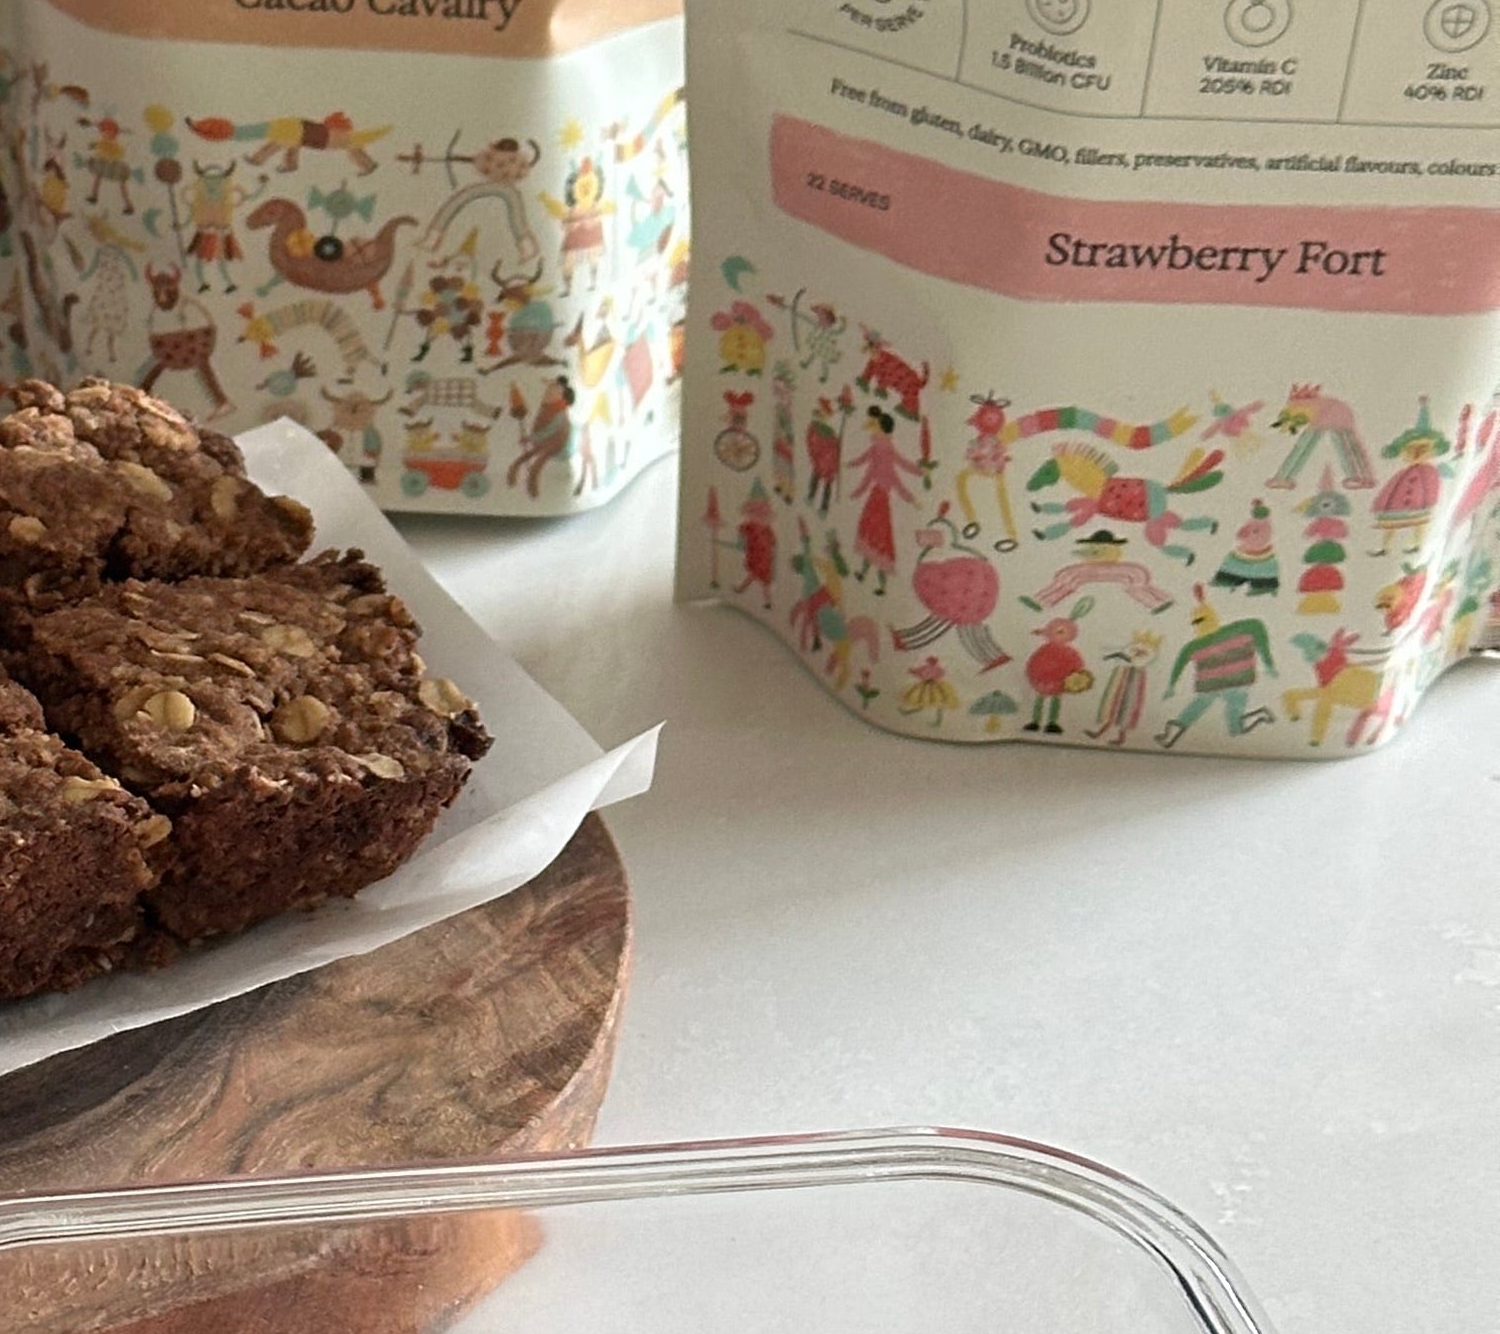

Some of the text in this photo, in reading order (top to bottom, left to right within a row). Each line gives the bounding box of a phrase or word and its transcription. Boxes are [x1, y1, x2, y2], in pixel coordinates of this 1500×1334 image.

[1010, 33, 1096, 69] Probiotics
[1203, 55, 1299, 75] Vitamin C
[1015, 58, 1065, 86] Billion
[1071, 72, 1111, 91] CFU
[1259, 78, 1293, 95] RDI
[1427, 63, 1469, 80] Zinc
[1404, 84, 1484, 102] 40% RDI
[831, 77, 866, 105] Free
[869, 91, 907, 117] from
[911, 105, 964, 138] gluten,
[968, 124, 1014, 153] dairy,
[1018, 138, 1071, 164] GMO,
[1075, 148, 1129, 169] fillers,
[1133, 152, 1260, 171] preservatives,
[1265, 153, 1340, 173] artificial
[1344, 155, 1423, 176] flavours,
[807, 172, 891, 211] 22 SERVES
[1045, 232, 1386, 283] Strawberry Fort
